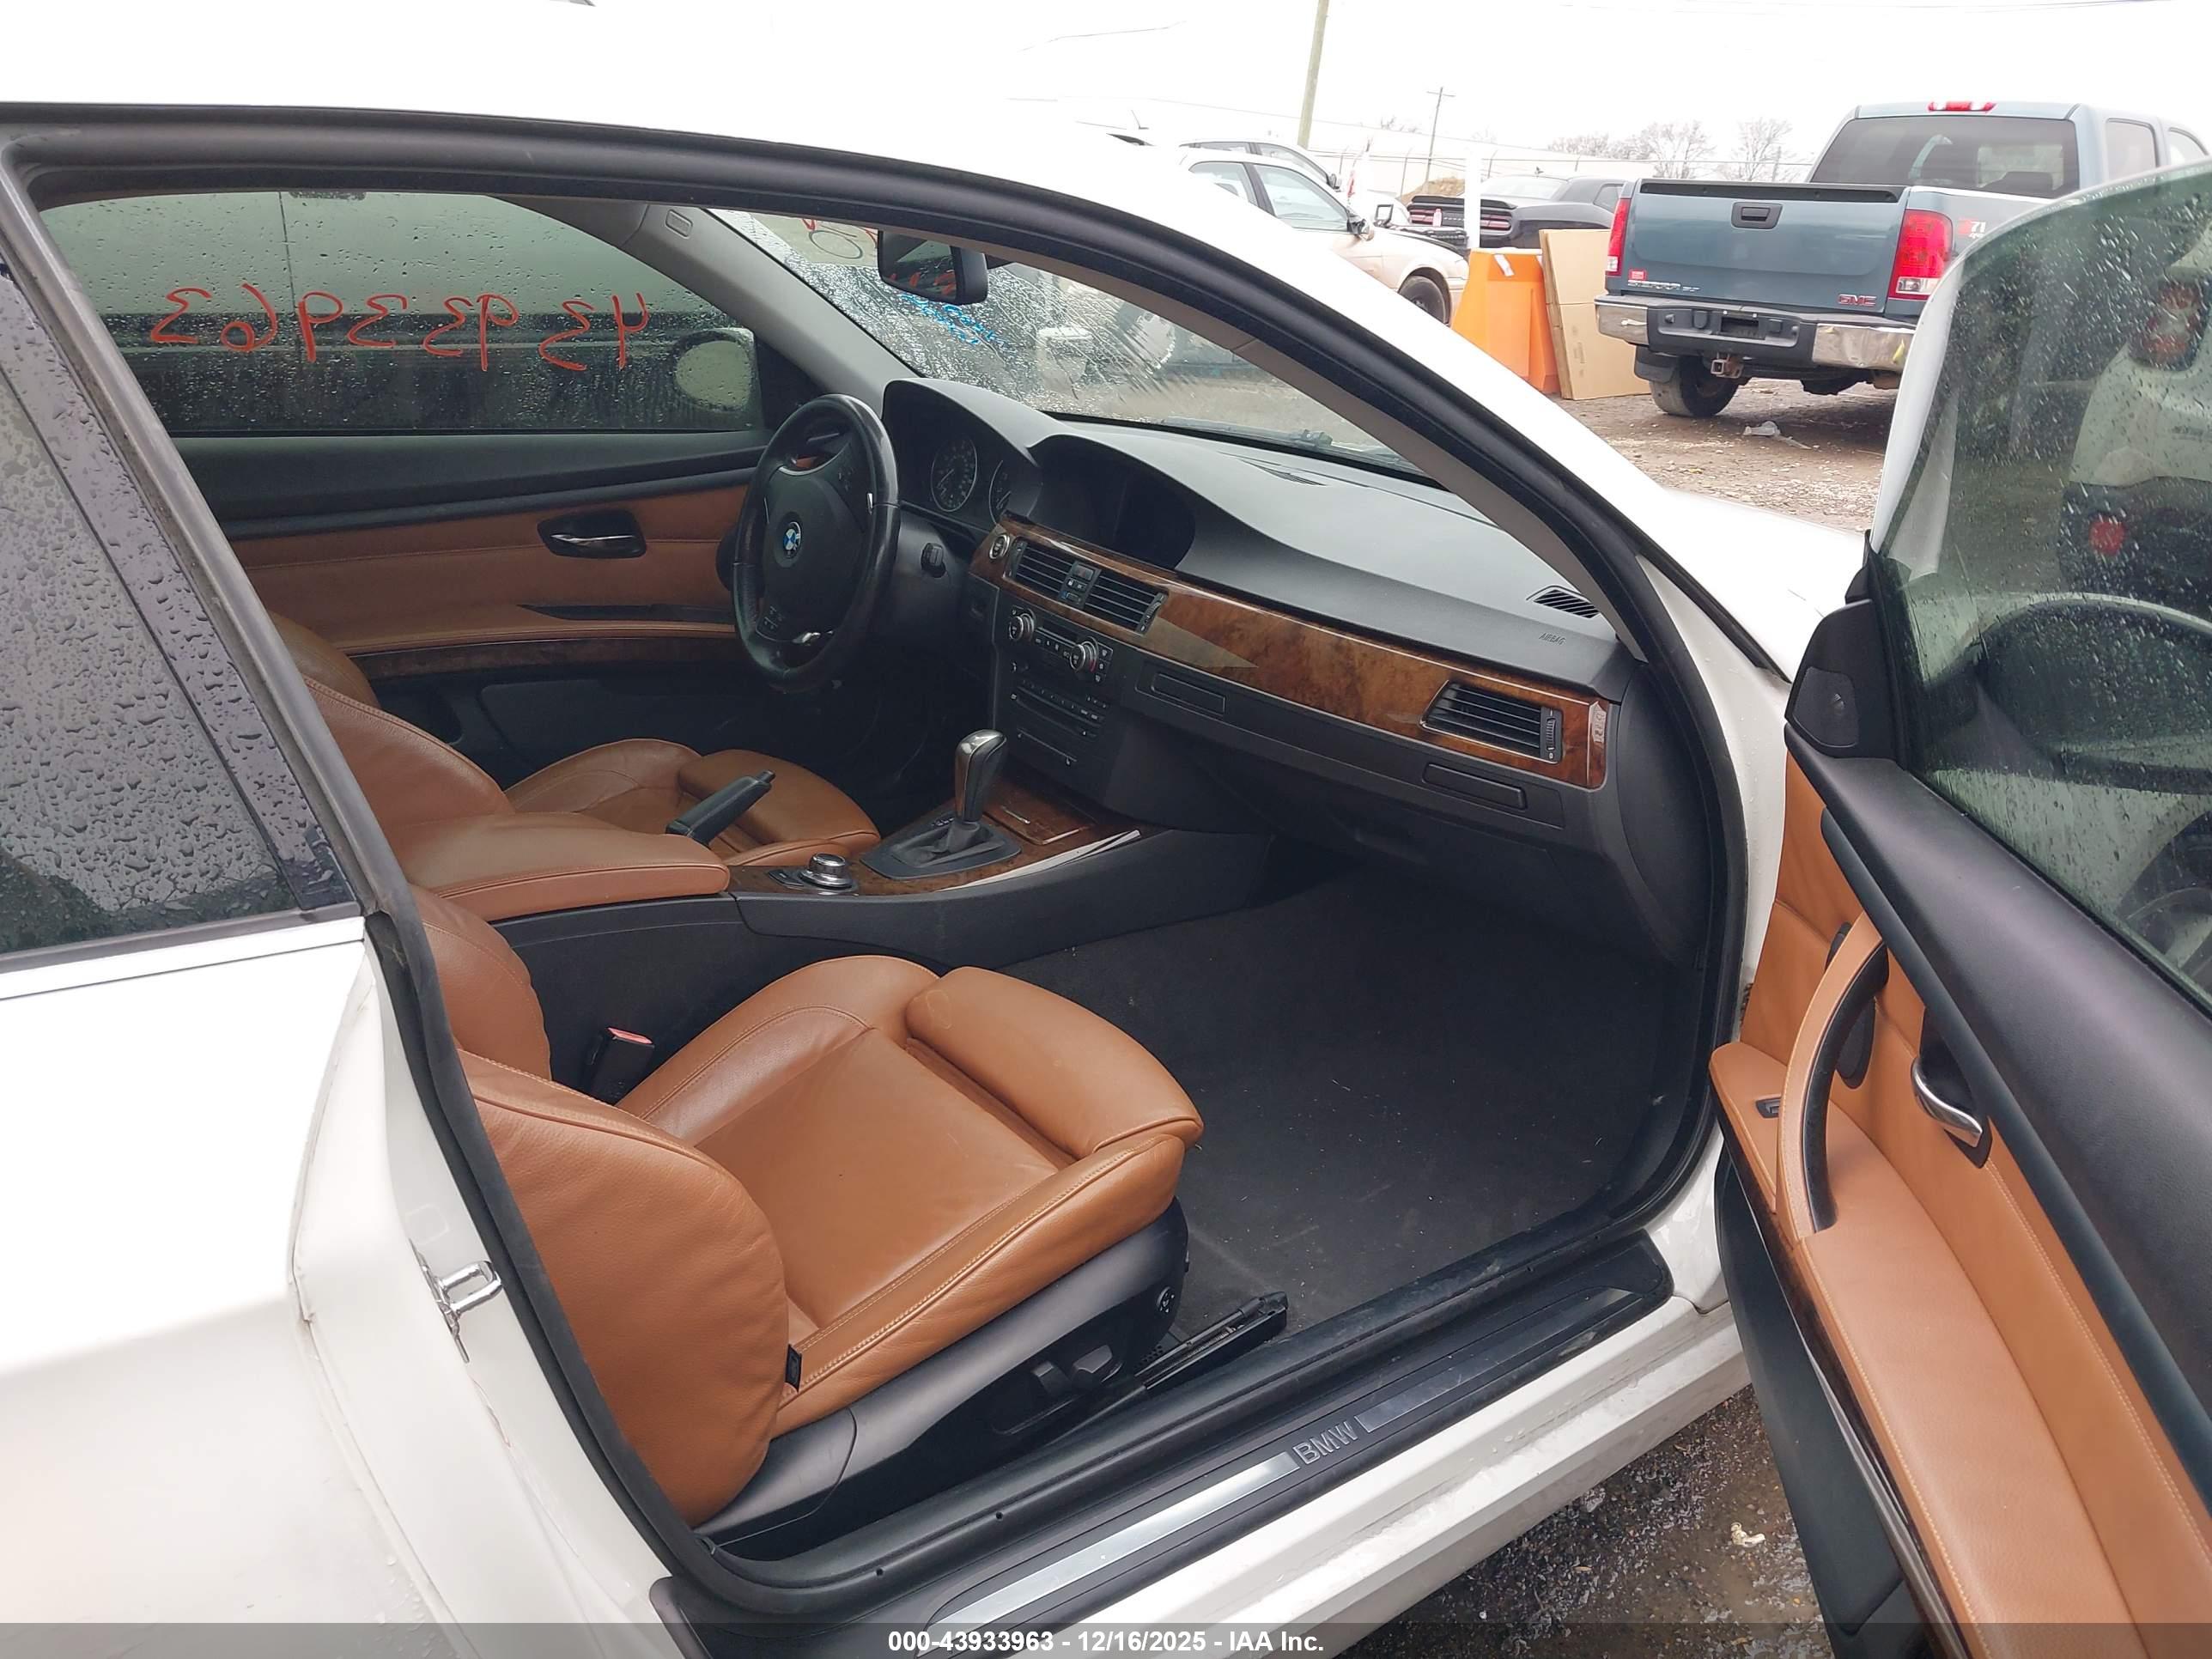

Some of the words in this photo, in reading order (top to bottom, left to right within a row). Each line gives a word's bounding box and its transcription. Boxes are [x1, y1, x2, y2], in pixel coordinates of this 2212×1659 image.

[1837, 294, 1877, 307] GMC
[1538, 632, 1567, 646] AIRBAG
[1291, 1420, 1358, 1465] BMW
